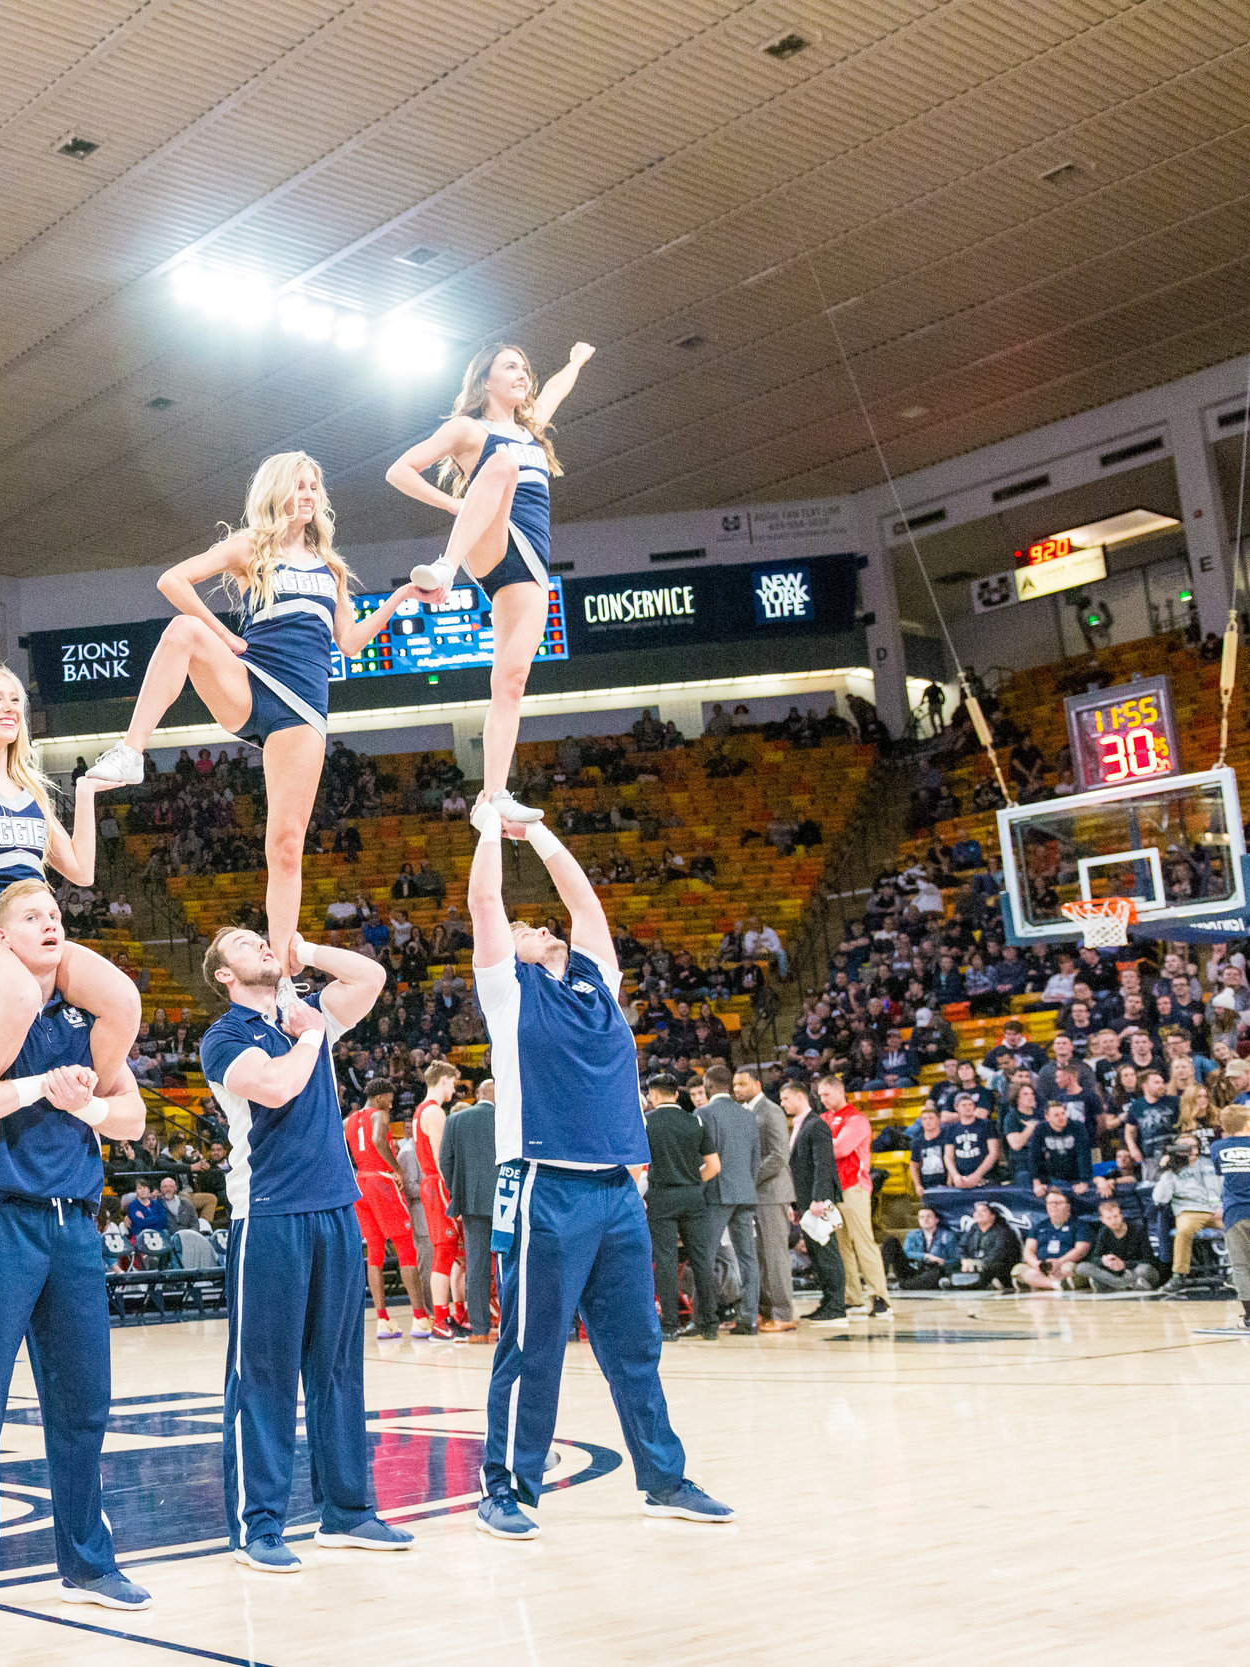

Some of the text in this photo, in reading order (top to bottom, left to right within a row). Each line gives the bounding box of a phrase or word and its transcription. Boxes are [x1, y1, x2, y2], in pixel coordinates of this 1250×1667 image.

[1028, 537, 1071, 565] 920
[1199, 555, 1213, 573] E
[760, 572, 803, 591] NEW
[584, 586, 695, 623] CONSERVICE
[755, 584, 811, 604] YORK
[765, 601, 807, 618] LIFE
[61, 640, 130, 662] ZIONS
[62, 659, 131, 682] BANK
[1094, 697, 1158, 733] 11:55
[1100, 728, 1156, 782] 30
[357, 1126, 366, 1152] 1
